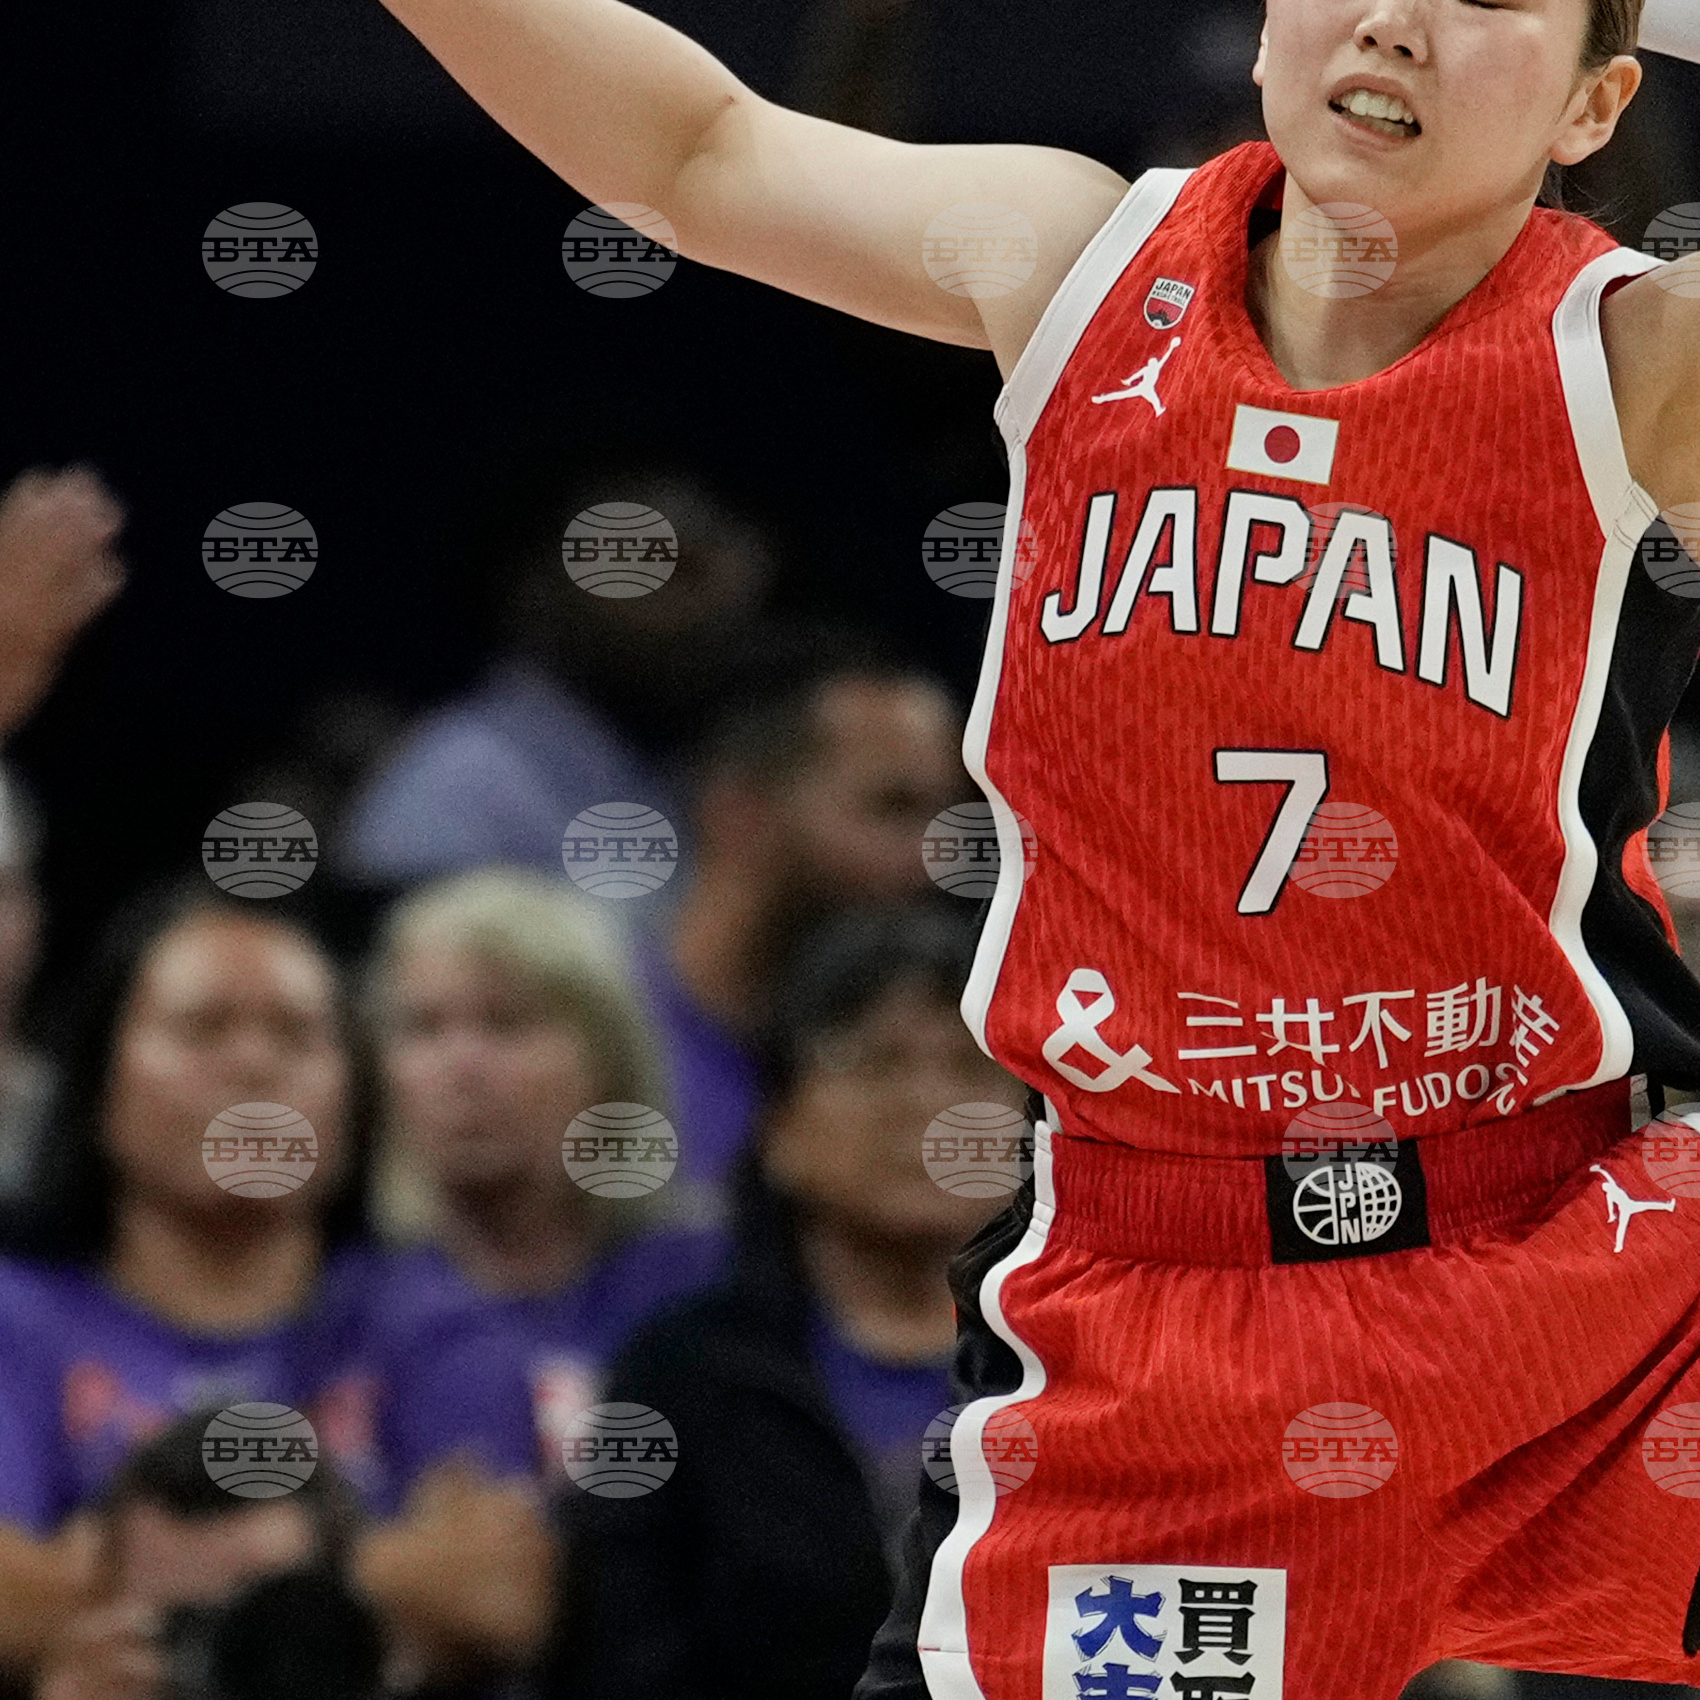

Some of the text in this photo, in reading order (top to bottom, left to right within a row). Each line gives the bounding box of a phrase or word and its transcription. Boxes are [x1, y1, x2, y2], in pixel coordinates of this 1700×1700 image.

[1155, 280, 1192, 300] JAPAN
[1039, 486, 1523, 719] JAPAN
[1213, 746, 1331, 916] 7
